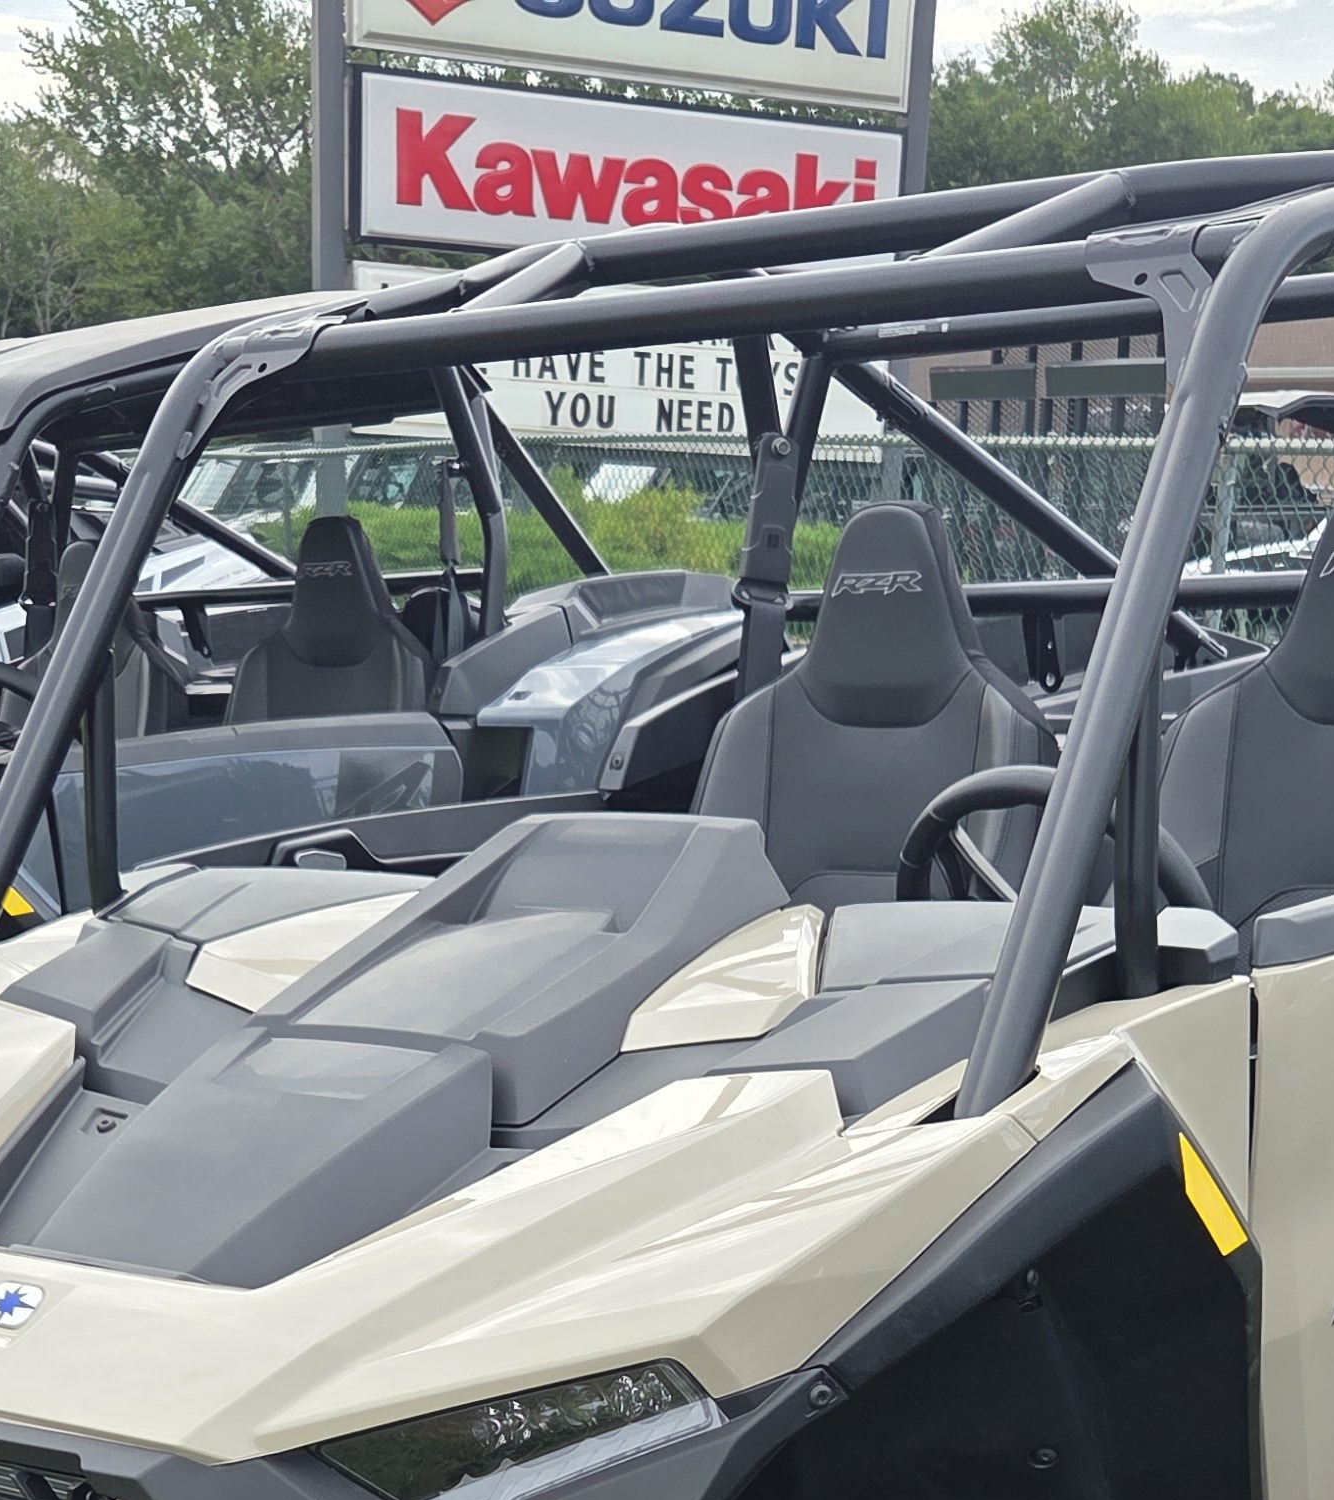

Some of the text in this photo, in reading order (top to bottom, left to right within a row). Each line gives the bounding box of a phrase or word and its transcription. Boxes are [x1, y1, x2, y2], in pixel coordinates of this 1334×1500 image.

[513, 0, 887, 59] ZUKI
[395, 107, 877, 226] Kawasaki
[512, 351, 799, 396] HAVE THE TS
[544, 390, 735, 433] YOU NEED
[831, 570, 923, 598] RZR
